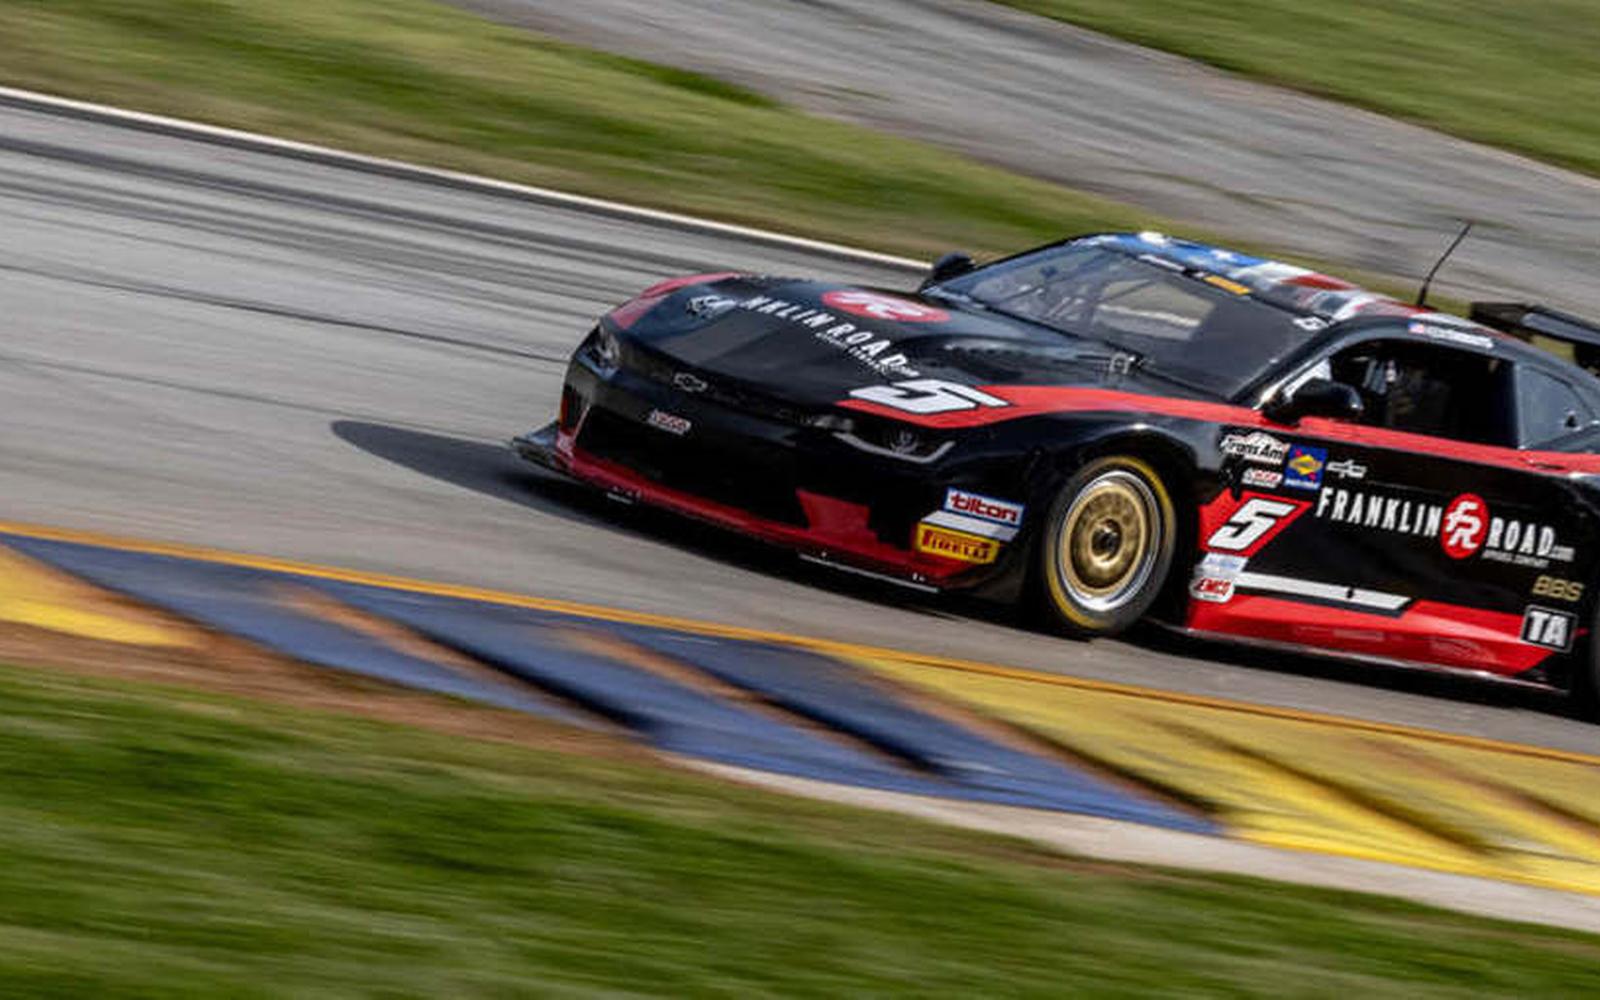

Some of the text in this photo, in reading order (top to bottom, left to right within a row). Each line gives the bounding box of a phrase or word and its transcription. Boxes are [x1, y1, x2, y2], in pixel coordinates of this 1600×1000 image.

[848, 377, 1012, 414] 5
[949, 493, 1020, 523] tilton
[1207, 498, 1296, 551] 5
[1316, 486, 1443, 538] FRANKLIN
[1532, 574, 1585, 602] BBS
[1528, 610, 1570, 648] TA
